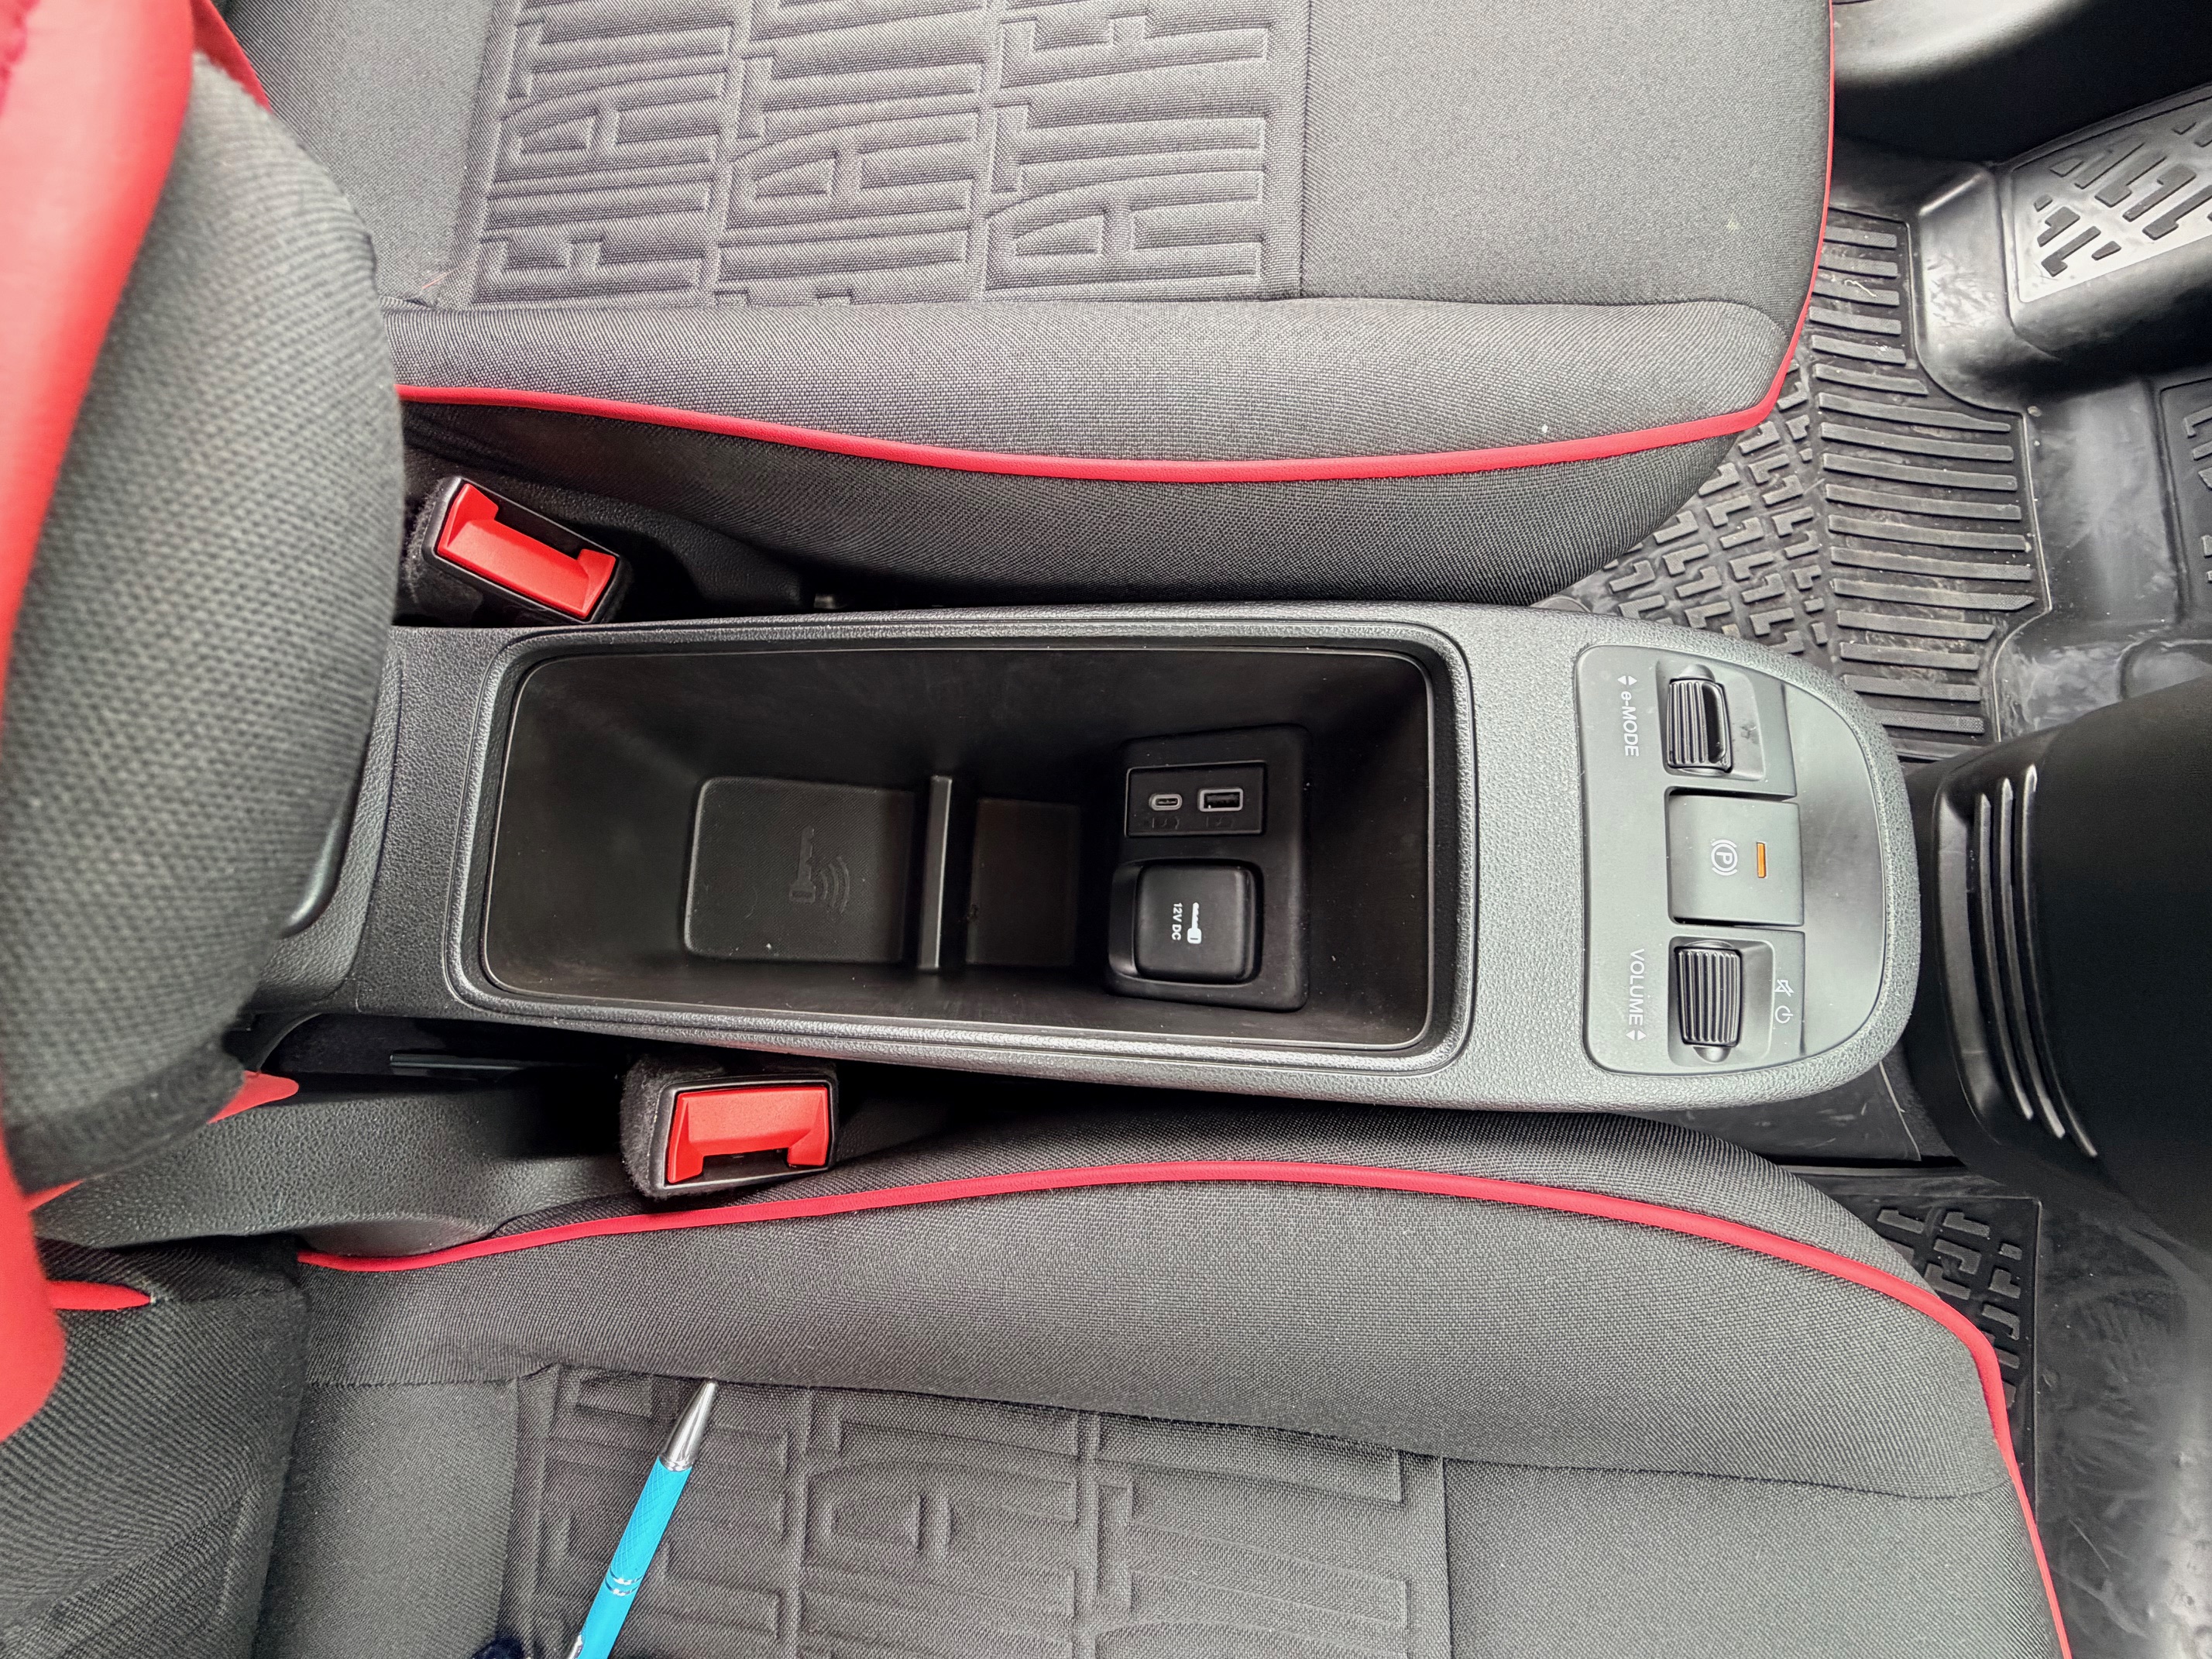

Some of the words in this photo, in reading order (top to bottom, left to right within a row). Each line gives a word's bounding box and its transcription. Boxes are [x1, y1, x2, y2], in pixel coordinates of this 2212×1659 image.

[713, 56, 981, 304] IAT
[1620, 690, 1640, 757] e-MODE
[1171, 924, 1182, 941] DC
[1173, 902, 1183, 922] 12V
[1630, 947, 1644, 1026] VOLUME
